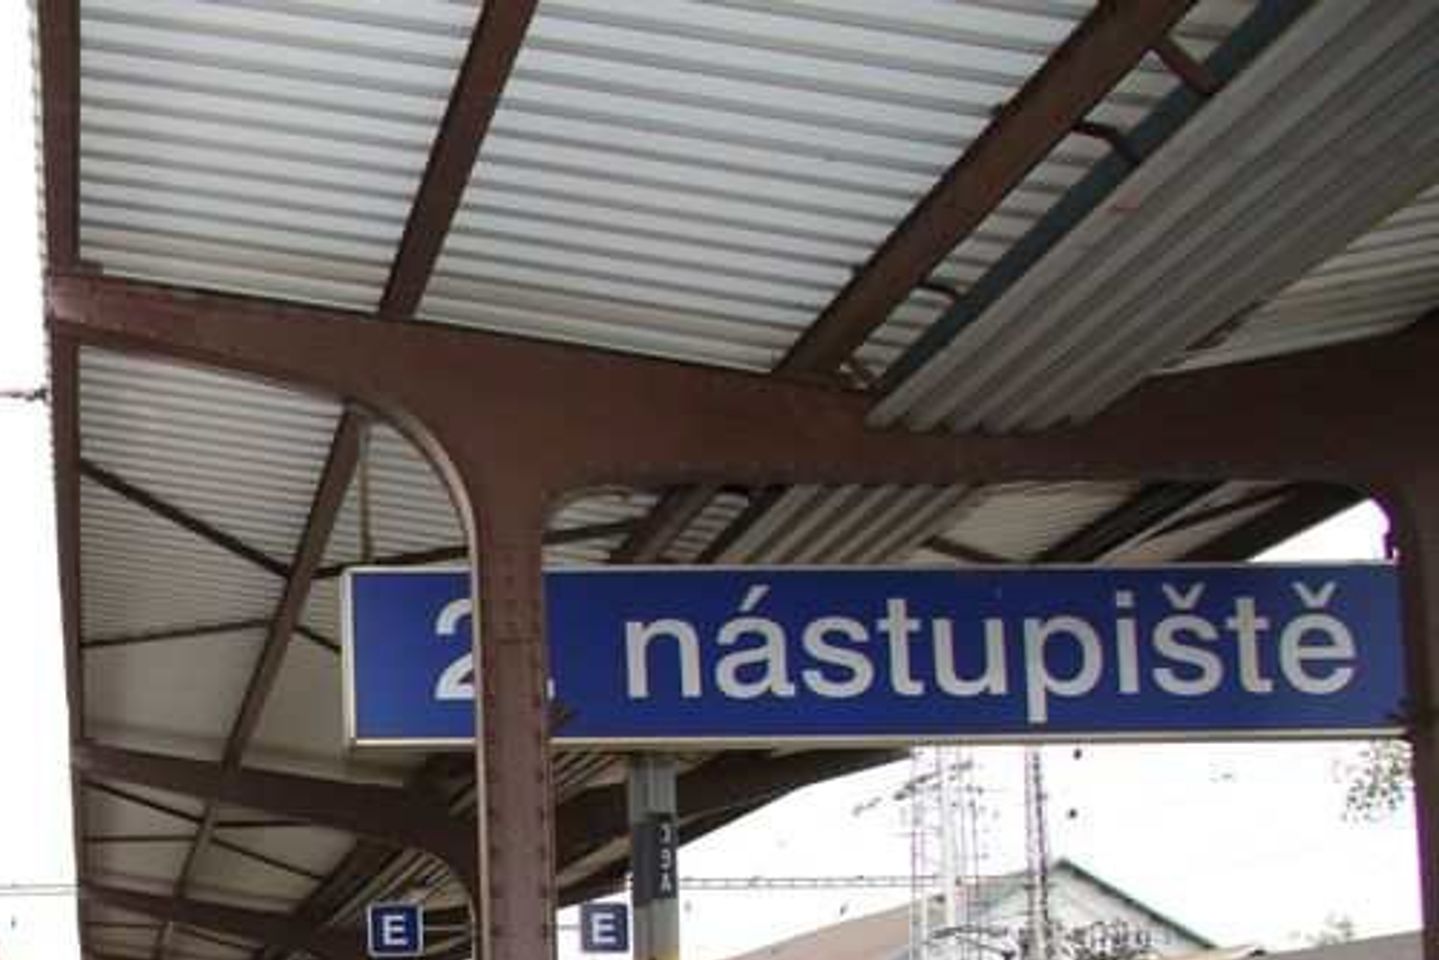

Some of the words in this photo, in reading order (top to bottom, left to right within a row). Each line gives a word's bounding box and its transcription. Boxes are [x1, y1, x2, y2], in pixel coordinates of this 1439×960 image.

[625, 582, 1356, 723] nástupiště
[382, 914, 407, 945] E
[591, 911, 617, 944] E
